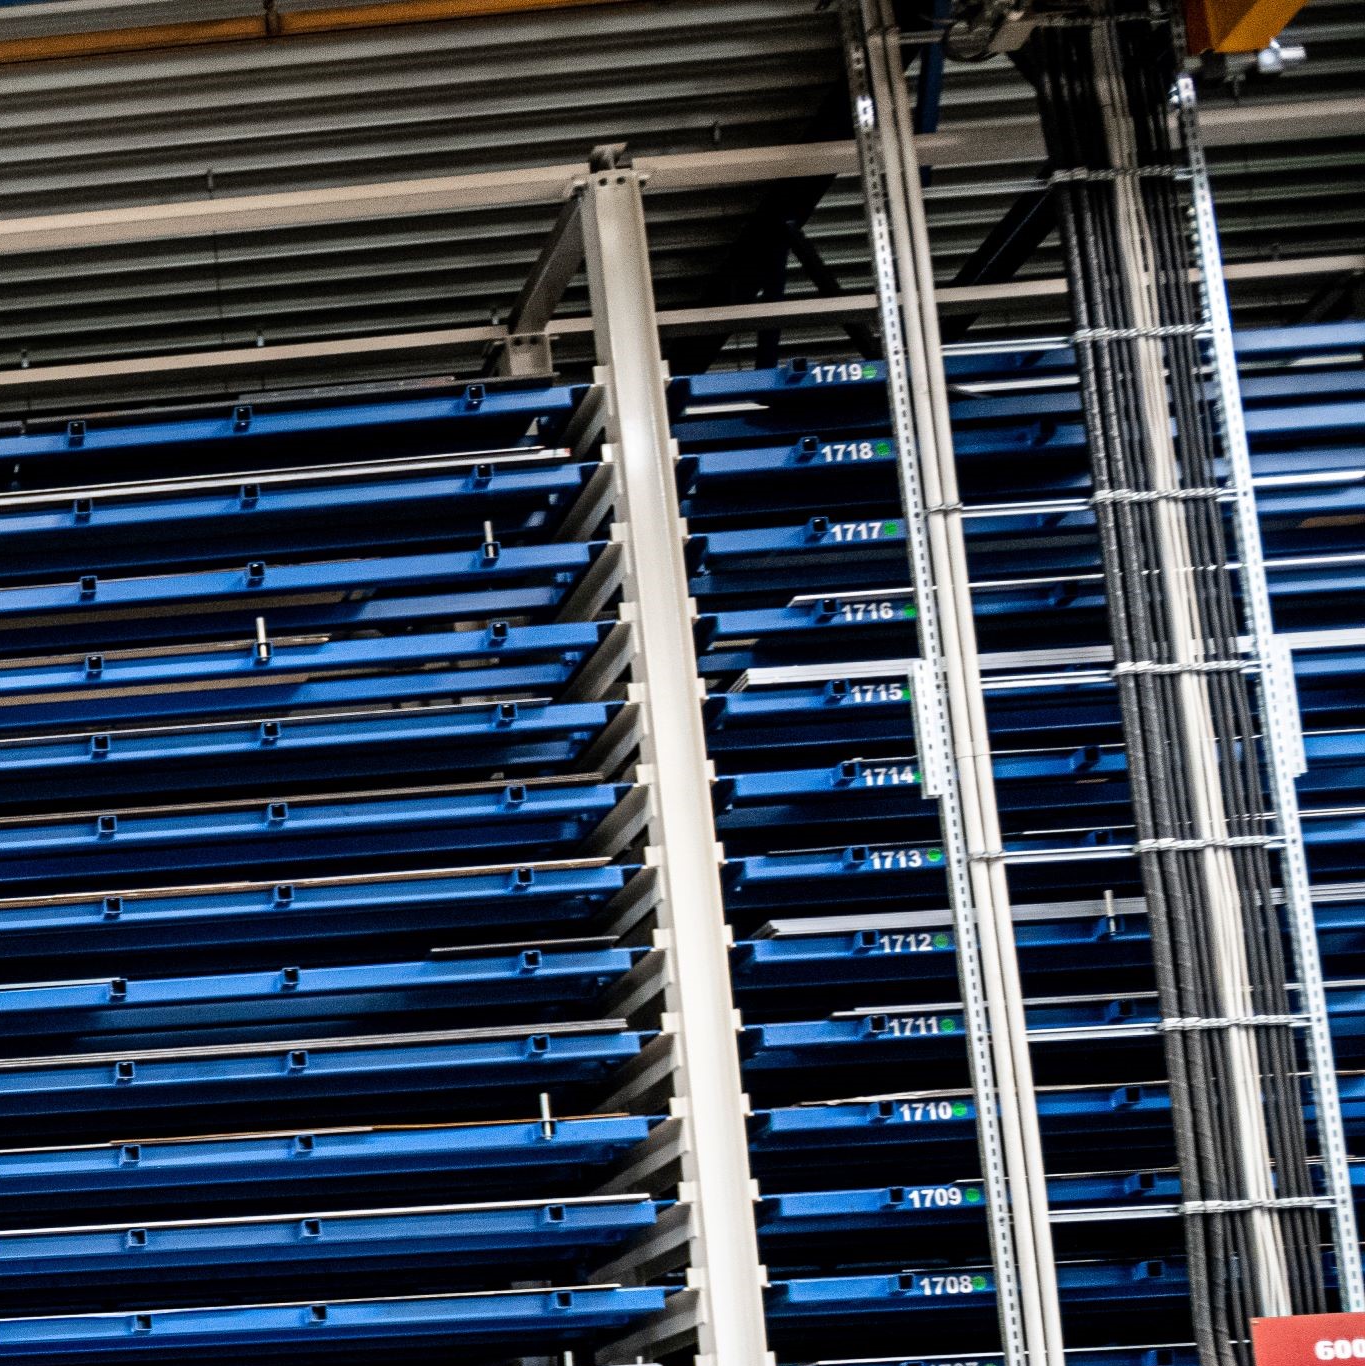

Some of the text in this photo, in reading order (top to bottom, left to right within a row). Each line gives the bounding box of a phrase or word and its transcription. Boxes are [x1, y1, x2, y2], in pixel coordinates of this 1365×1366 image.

[811, 363, 862, 383] 1719
[821, 442, 874, 462] 1718
[831, 521, 882, 542] 1717
[841, 602, 894, 622] 1716
[850, 683, 903, 703] 1715
[862, 766, 914, 786] 1714
[869, 849, 922, 870] 1713
[879, 933, 933, 953] 1712
[889, 1016, 939, 1037] 1711
[899, 1101, 953, 1122] 1710
[908, 1187, 962, 1208] 1709
[920, 1275, 974, 1296] 1708
[1314, 1338, 1365, 1361] 600
